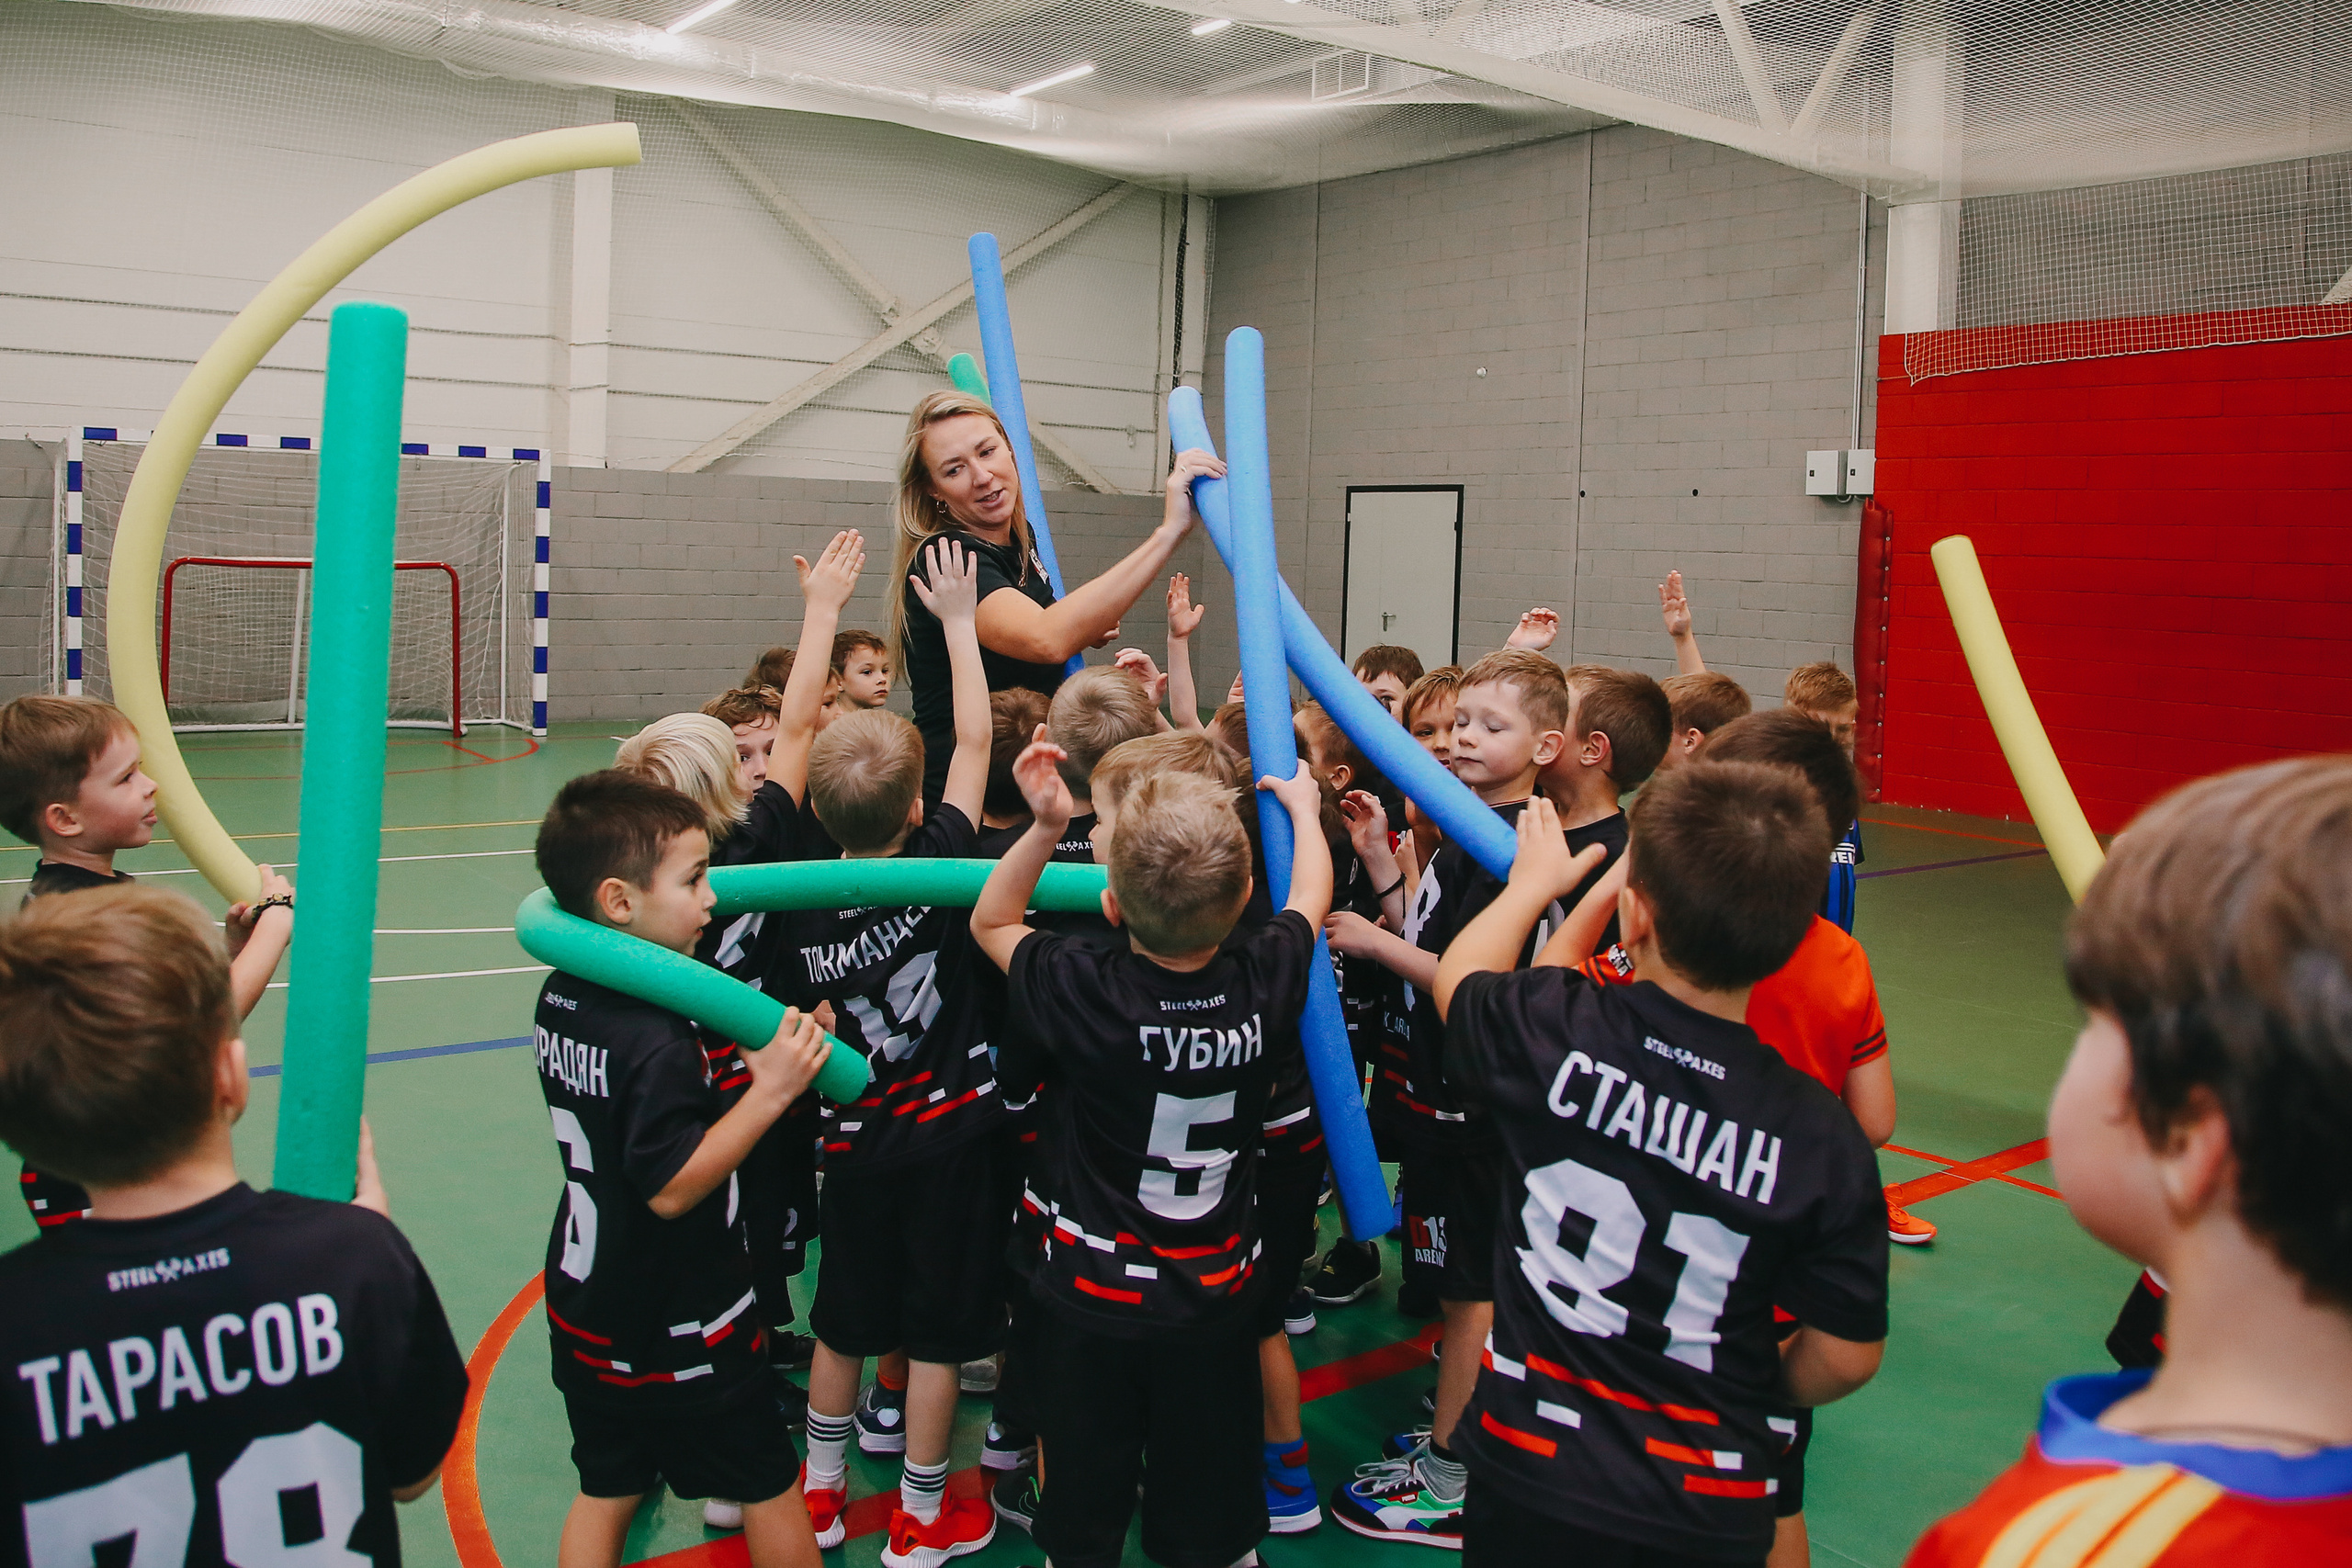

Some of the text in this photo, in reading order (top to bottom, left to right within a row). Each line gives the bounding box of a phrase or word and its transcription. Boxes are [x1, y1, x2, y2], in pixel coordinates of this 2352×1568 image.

[838, 908, 859, 919] STEEL
[843, 950, 943, 1083] 19
[1139, 1013, 1262, 1072] ГУБИН
[1159, 994, 1227, 1011] STEEL AXES
[1643, 1035, 1726, 1080] STEEL AXES
[1137, 1089, 1238, 1221] 5
[1547, 1049, 1782, 1205] СТАШАН
[107, 1247, 232, 1292] STEEL AXES
[1514, 1158, 1751, 1374] 81
[17, 1292, 345, 1446] ТАРАСОВ
[22, 1420, 374, 1568] 78
